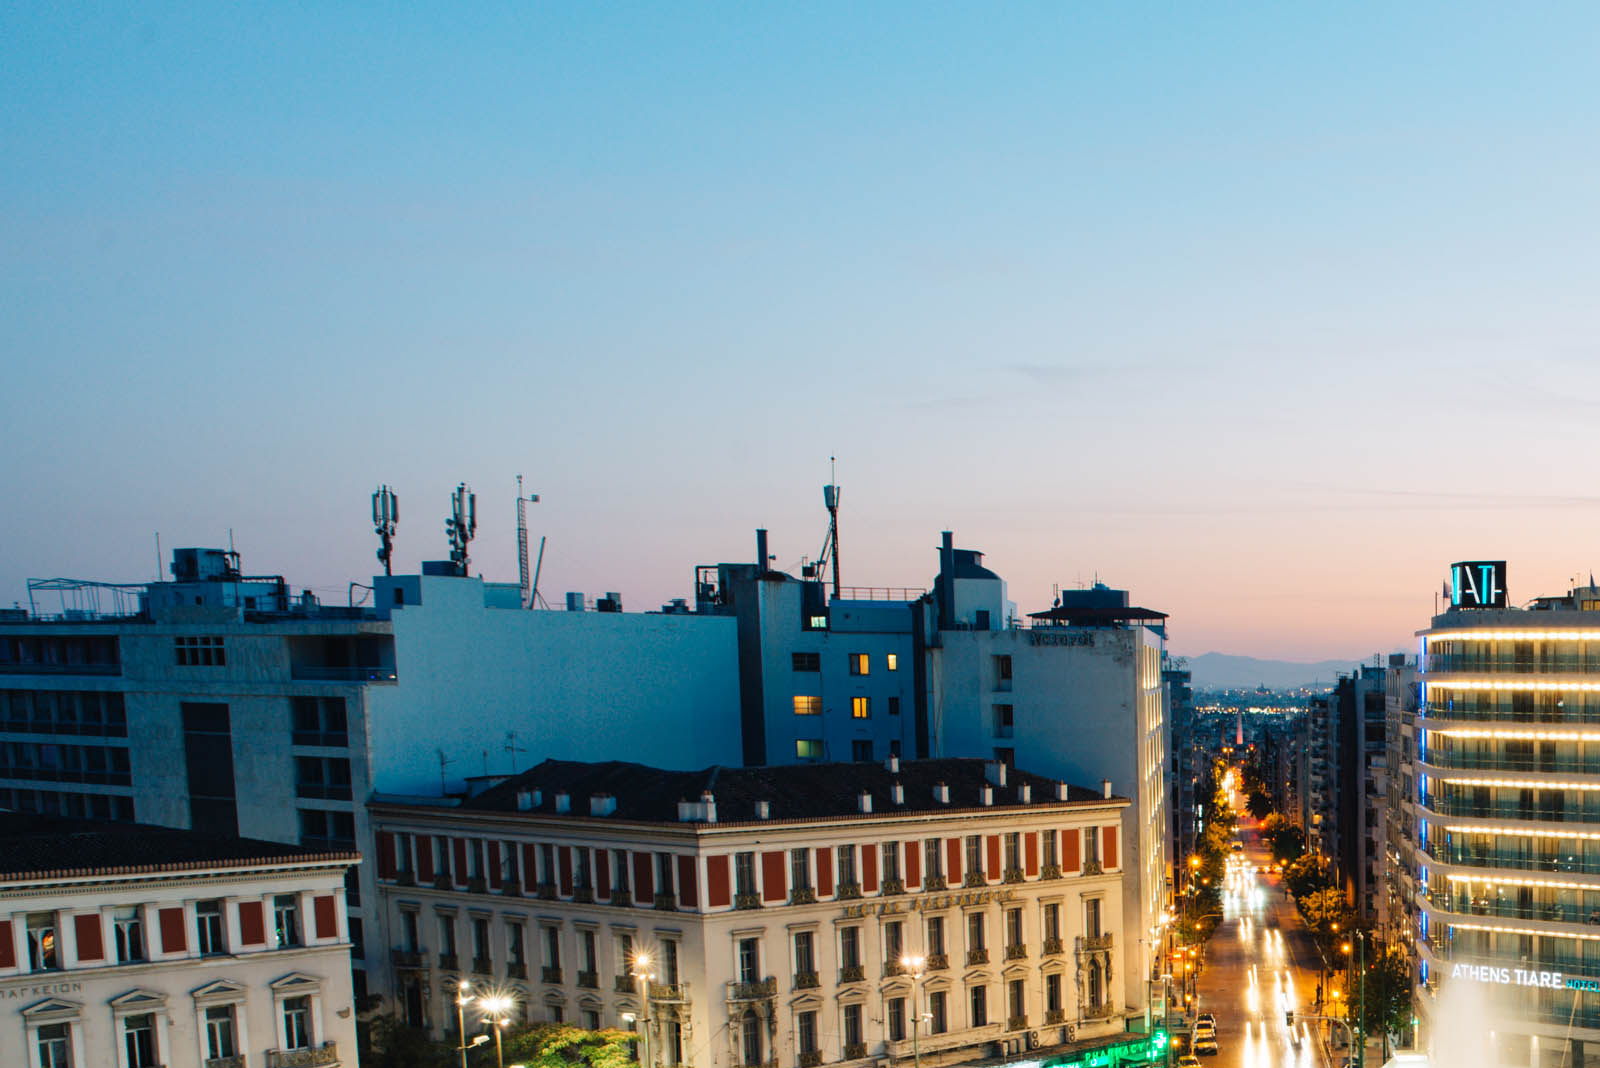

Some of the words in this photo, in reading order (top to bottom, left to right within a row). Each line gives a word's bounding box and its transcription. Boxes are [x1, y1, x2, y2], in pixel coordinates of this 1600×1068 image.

[1451, 963, 1511, 985] ATHENS
[1513, 968, 1563, 989] TIARE
[1565, 979, 1600, 993] HOTEL
[1085, 1042, 1146, 1061] PHARMACY
